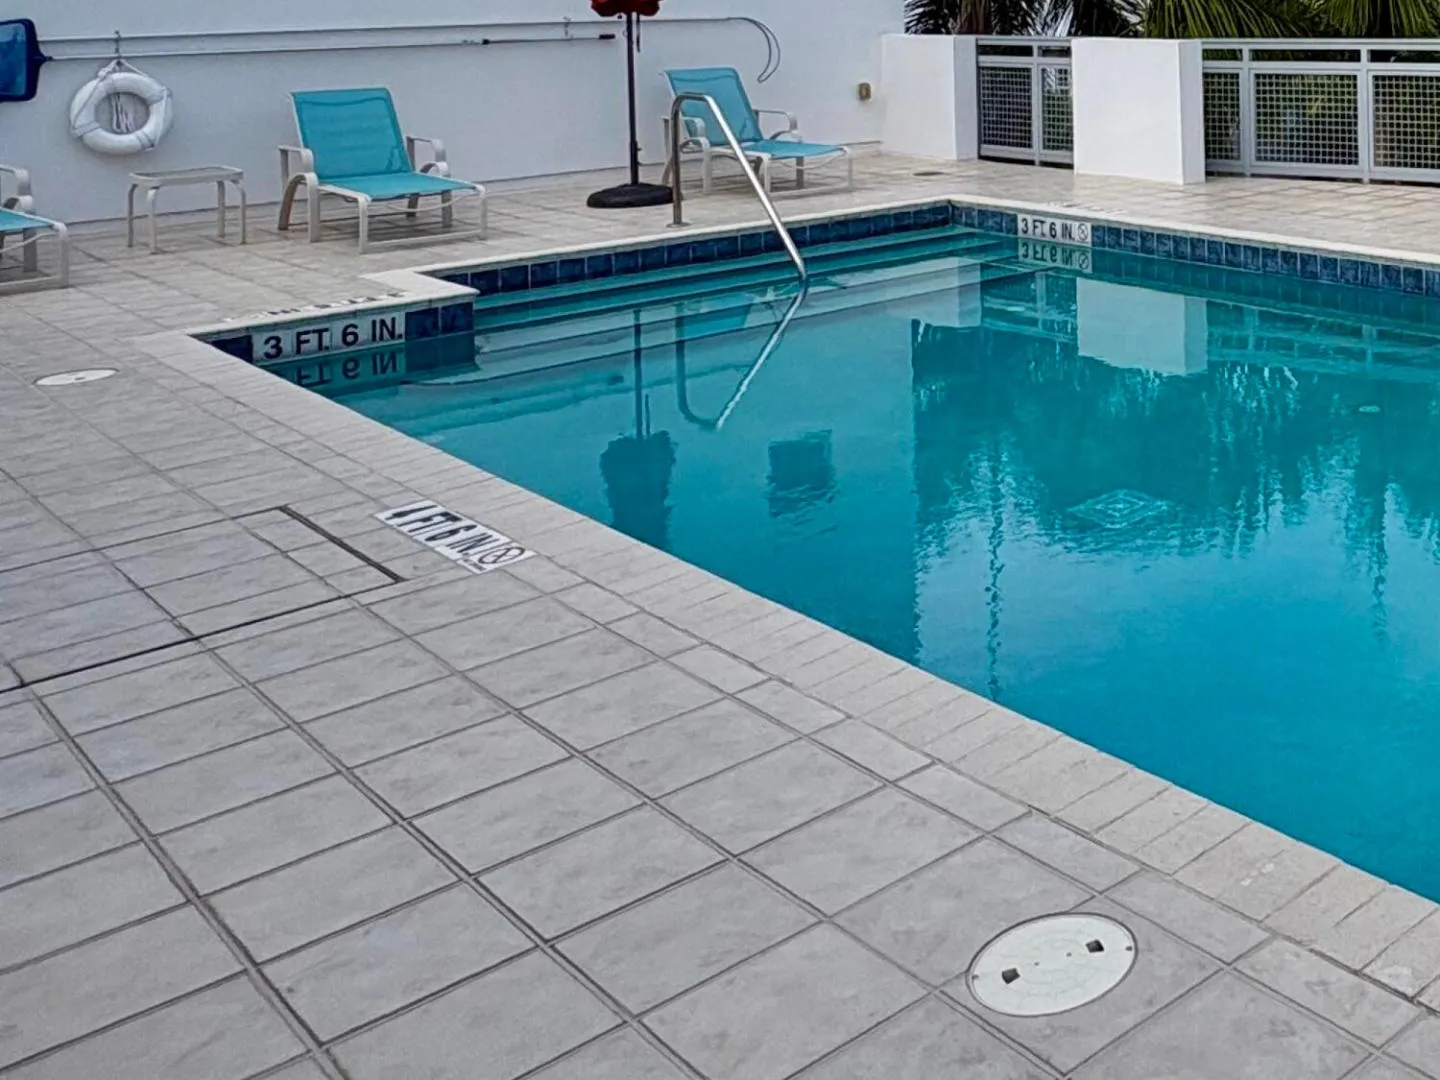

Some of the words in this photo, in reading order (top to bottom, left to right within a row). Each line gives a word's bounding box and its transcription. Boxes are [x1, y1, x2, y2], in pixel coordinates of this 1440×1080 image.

[1021, 217, 1029, 235] 3
[1049, 221, 1057, 239] 6
[264, 335, 283, 359] 3
[296, 327, 329, 355] FT.
[341, 323, 360, 347] 6
[371, 317, 403, 343] IN.
[397, 512, 463, 533] FT
[425, 525, 478, 541] 6
